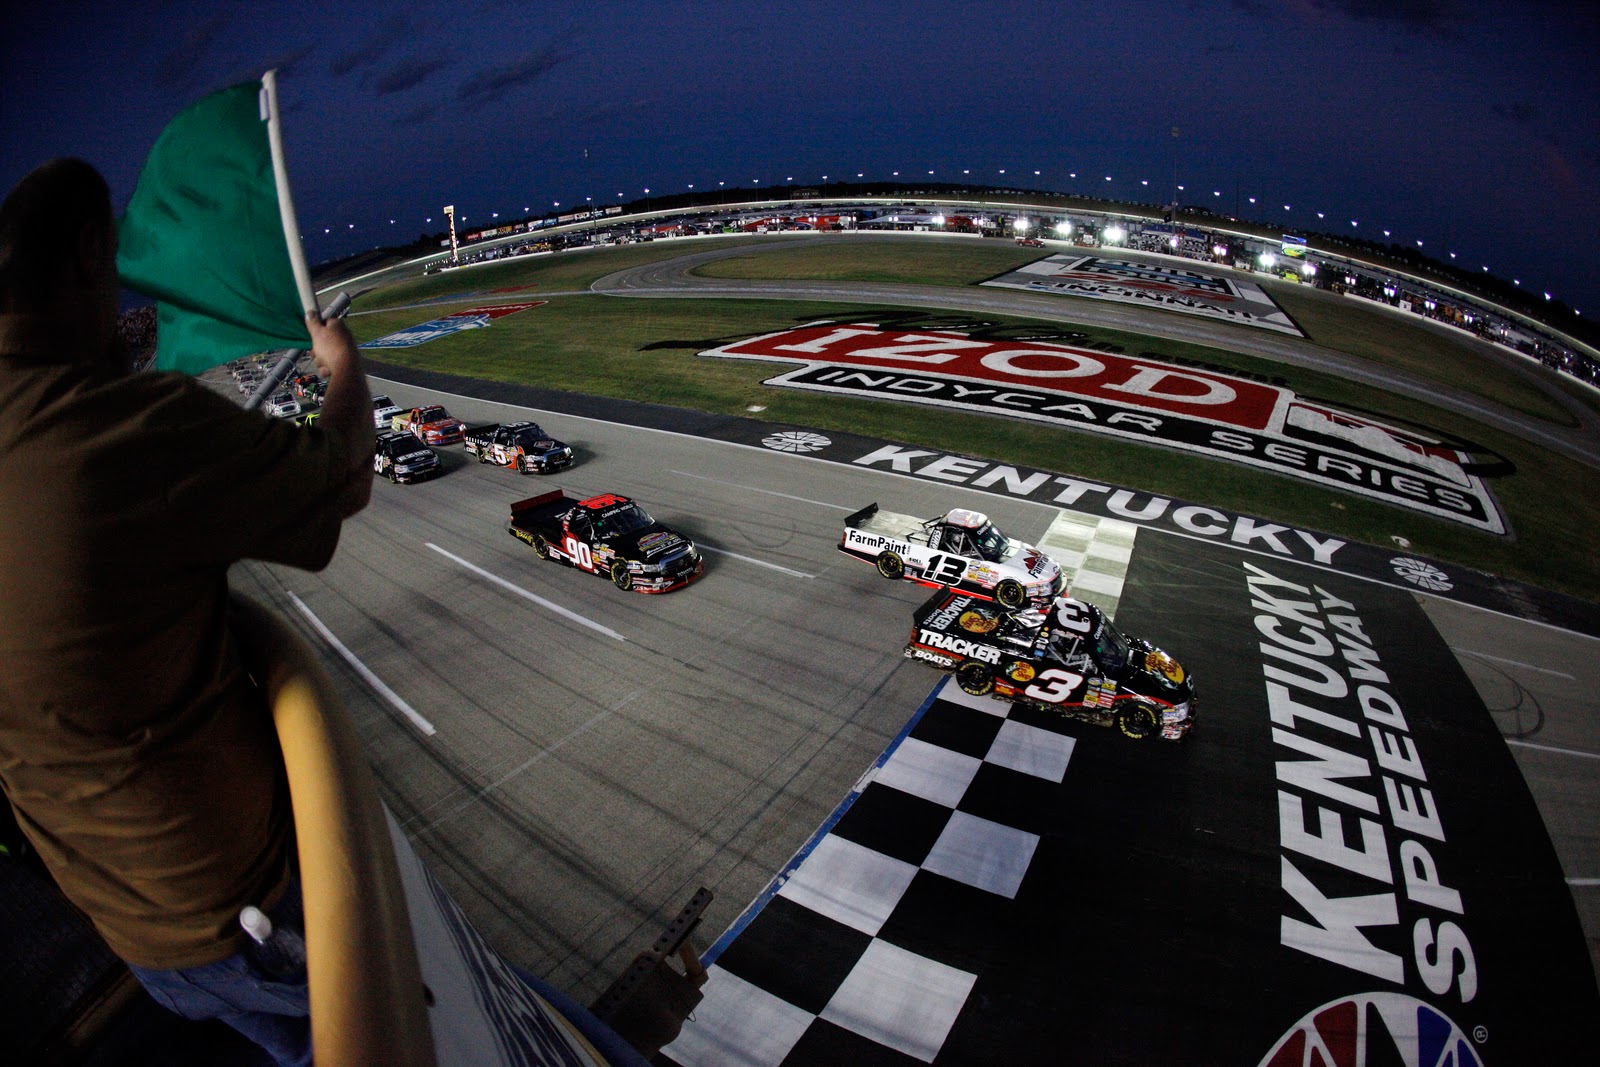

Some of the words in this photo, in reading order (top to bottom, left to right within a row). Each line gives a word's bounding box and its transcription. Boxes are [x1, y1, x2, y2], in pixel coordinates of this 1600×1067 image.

[1079, 266, 1227, 294] TOUGH
[1030, 280, 1254, 320] CINCINNATI
[772, 328, 1237, 405] IZOD
[817, 370, 1163, 432] INDYCAR
[1210, 430, 1473, 512] SERIES
[853, 444, 1347, 565] KENTUCKY
[566, 537, 593, 569] 90
[849, 530, 907, 555] FarmPaint
[922, 554, 968, 587] 13
[930, 596, 971, 631] TRACKER
[1056, 598, 1091, 633] 3
[915, 650, 954, 666] BOATS
[919, 629, 1002, 665] TRACKER
[1024, 668, 1084, 703] 3
[1243, 561, 1404, 985] KENTUCKY
[1314, 584, 1477, 1003] SPEEDWAY
